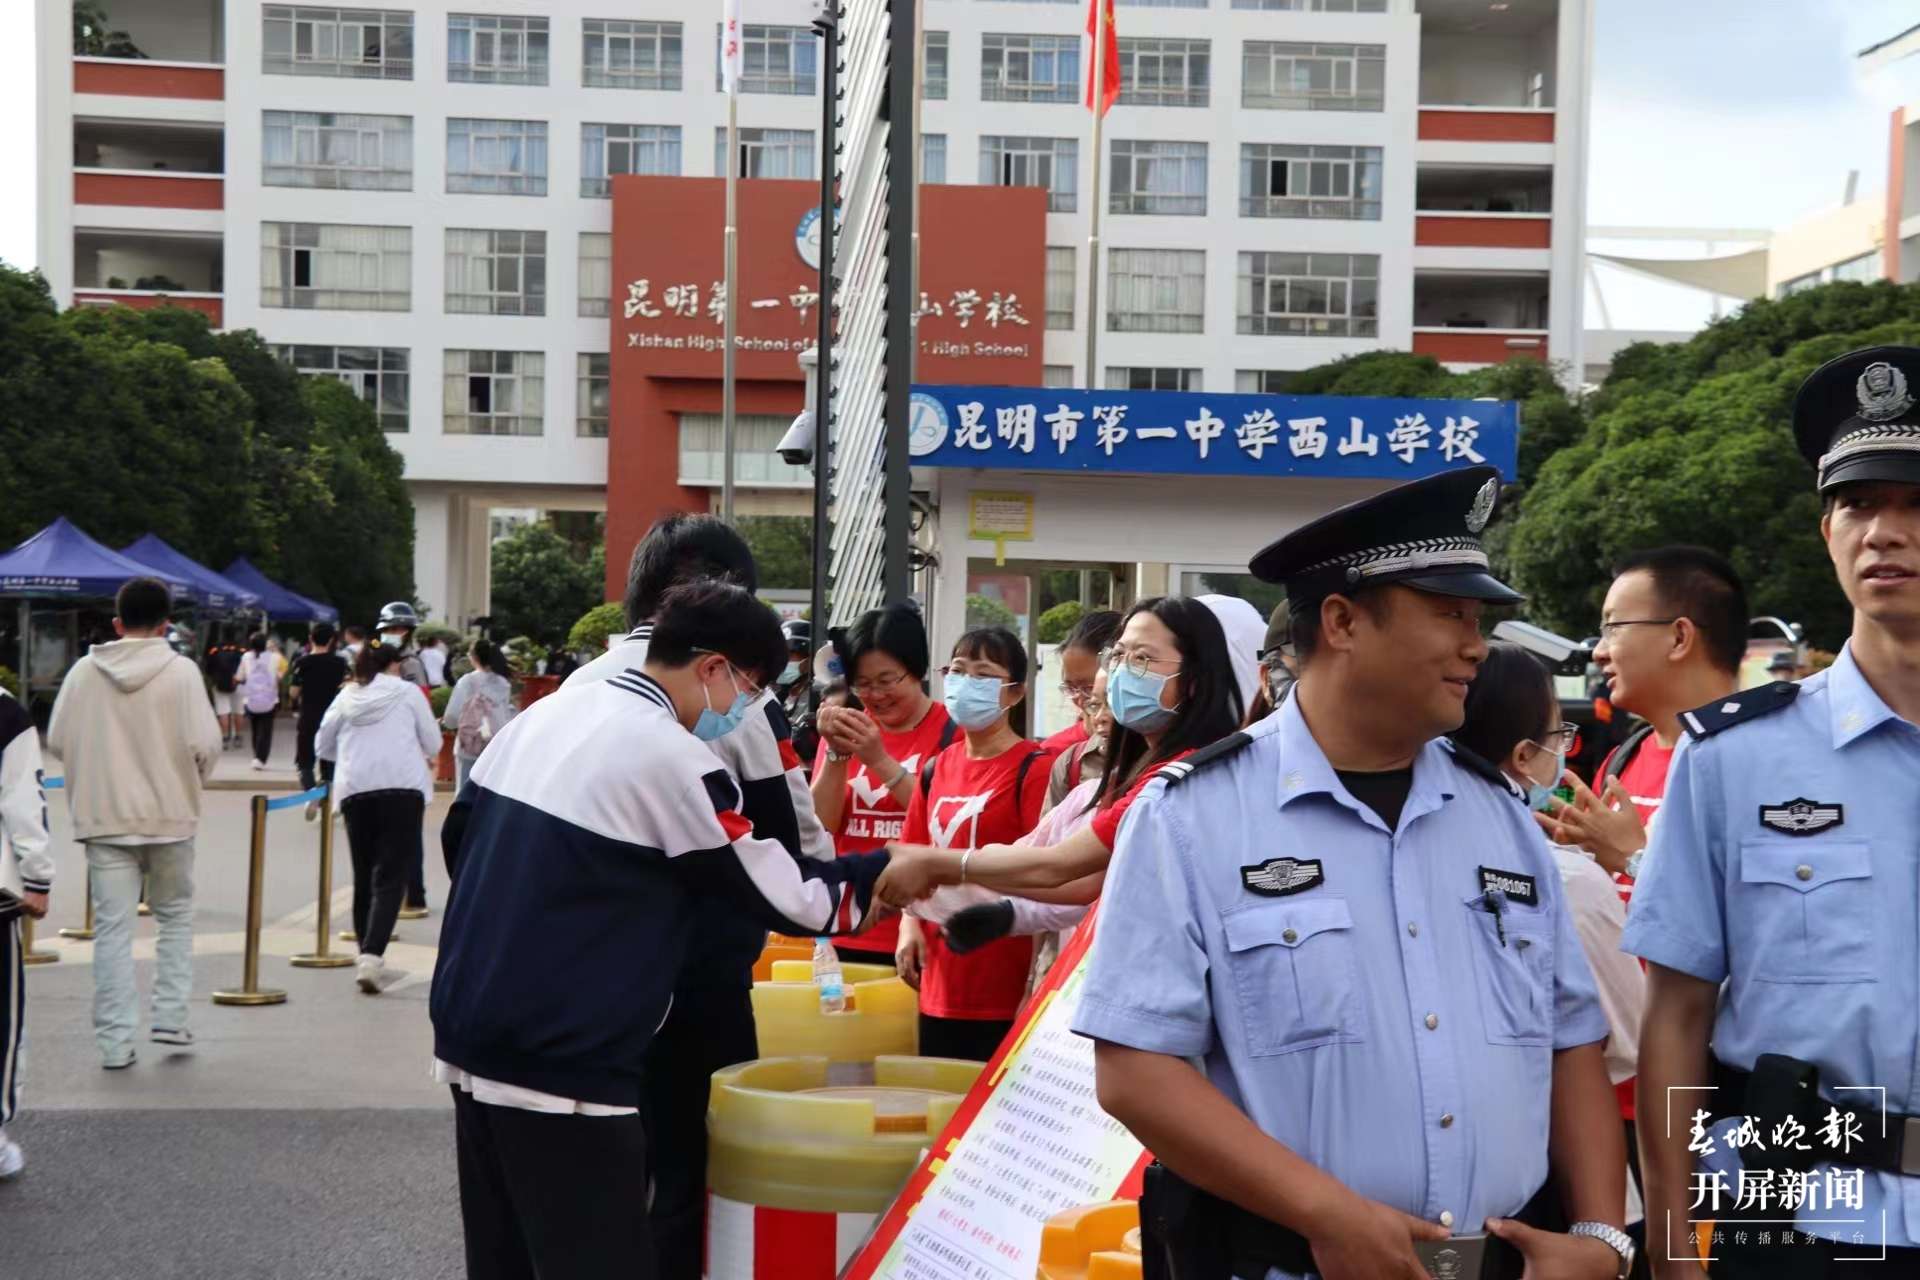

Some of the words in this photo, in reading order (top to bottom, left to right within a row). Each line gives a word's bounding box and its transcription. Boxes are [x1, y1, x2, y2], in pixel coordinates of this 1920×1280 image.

[623, 278, 1030, 328] 昆明第一中山学校
[627, 333, 684, 349] Xishan
[688, 335, 725, 352] High
[734, 336, 789, 351] School
[932, 341, 970, 358] High
[974, 341, 1029, 357] School
[953, 401, 1487, 465] 昆明市第一中学西山学校
[845, 818, 870, 838] ALL
[873, 820, 905, 840] RIG
